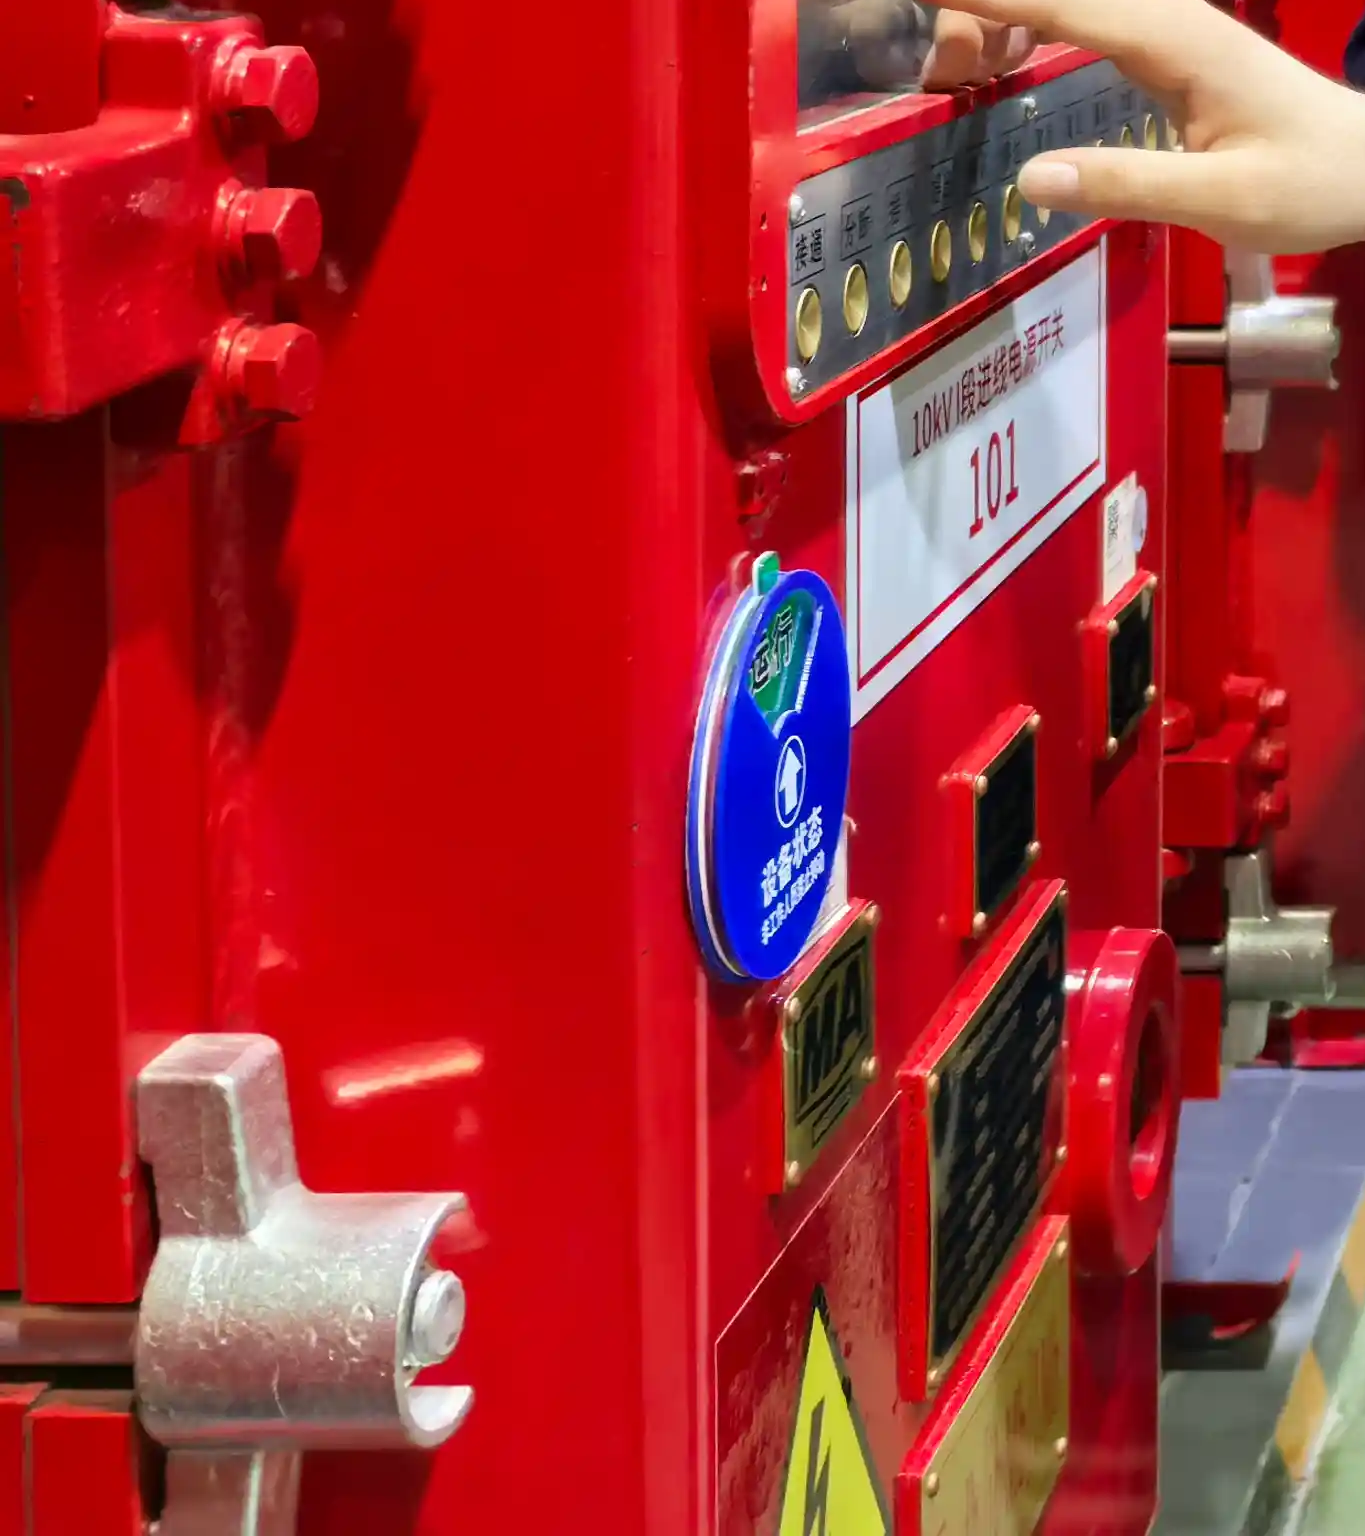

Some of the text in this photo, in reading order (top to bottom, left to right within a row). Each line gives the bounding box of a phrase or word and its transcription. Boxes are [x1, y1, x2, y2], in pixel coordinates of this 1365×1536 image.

[968, 419, 1020, 539] 101
[761, 805, 823, 908] 设备状态
